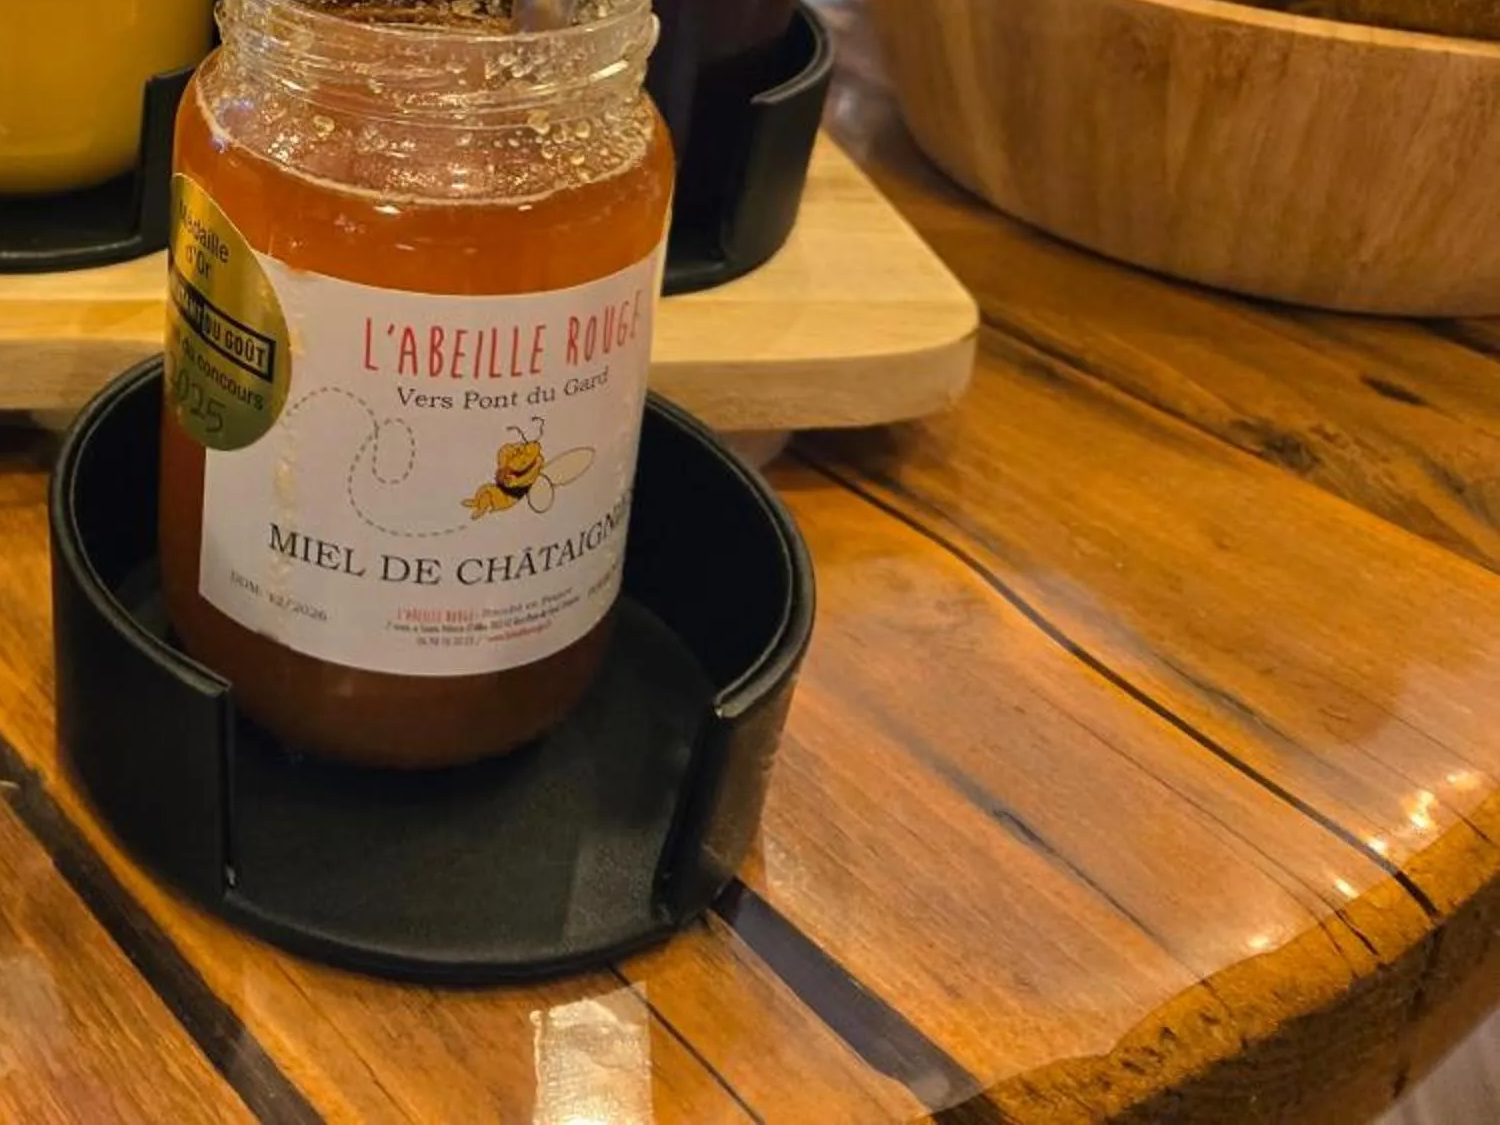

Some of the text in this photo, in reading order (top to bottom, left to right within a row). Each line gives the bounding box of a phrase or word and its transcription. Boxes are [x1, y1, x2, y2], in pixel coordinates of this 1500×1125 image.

[363, 290, 643, 380] L'ABEILLE ROUGE
[397, 365, 610, 411] Vers Pont du Gard
[268, 522, 367, 577] MIEL
[380, 553, 442, 586] DE
